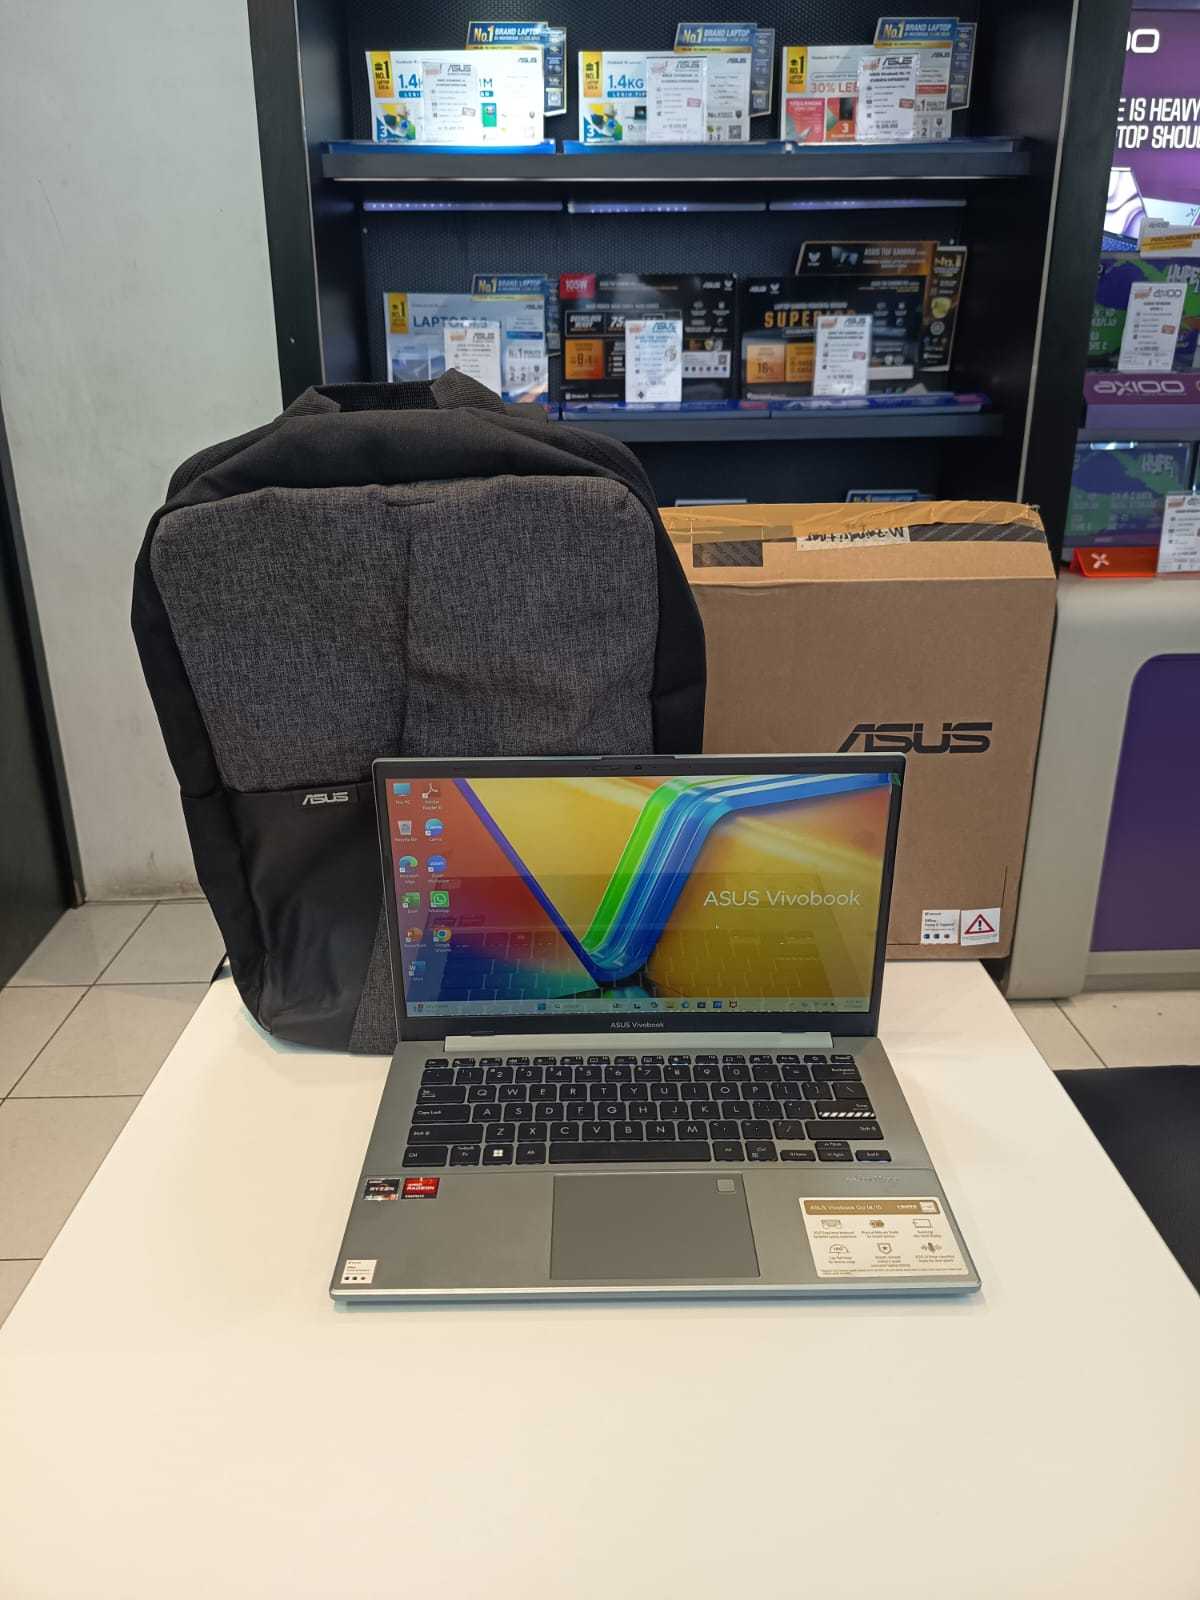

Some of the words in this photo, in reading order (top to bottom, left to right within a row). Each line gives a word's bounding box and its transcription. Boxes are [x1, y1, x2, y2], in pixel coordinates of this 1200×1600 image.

[474, 26, 495, 42] No.1
[495, 28, 516, 36] BRAND
[682, 29, 704, 44] No.1
[727, 29, 750, 37] LAPTOP
[884, 21, 905, 40] No.1
[928, 23, 950, 31] LAPTOP
[1126, 29, 1159, 53] O
[447, 64, 472, 73] ASUS
[882, 56, 913, 66] ASUS
[608, 74, 644, 89] 1.4KG
[811, 82, 834, 93] 30%
[1129, 98, 1147, 121] IS
[1149, 98, 1200, 121] HEAVY
[587, 125, 594, 137] 3
[842, 124, 849, 133] 3
[1117, 126, 1149, 149] TOP
[479, 279, 497, 292] No.1
[838, 722, 992, 753] ASUS
[302, 792, 349, 805] ASUS
[704, 890, 760, 906] ASUS
[767, 889, 860, 906] Vivobook
